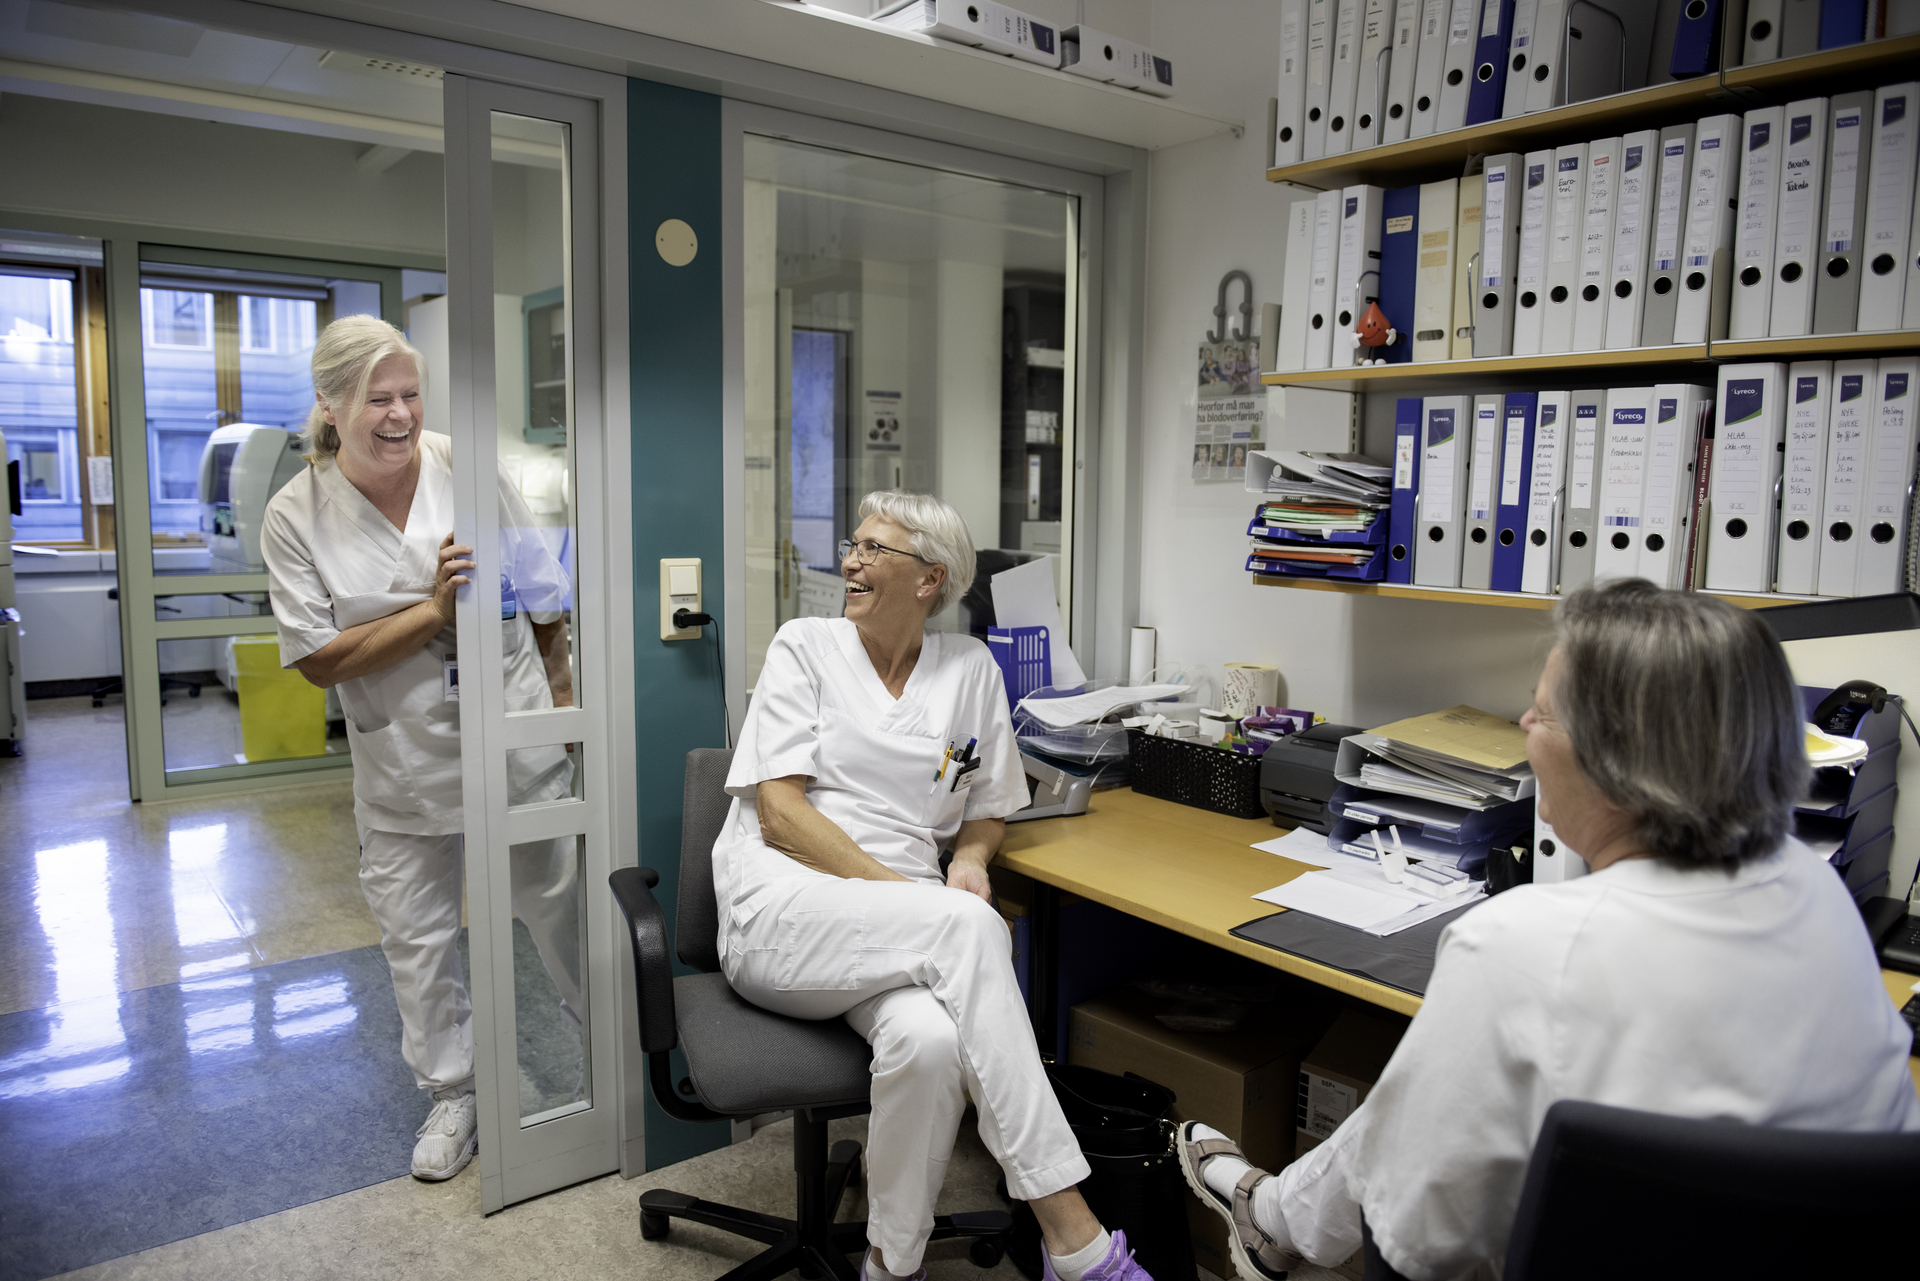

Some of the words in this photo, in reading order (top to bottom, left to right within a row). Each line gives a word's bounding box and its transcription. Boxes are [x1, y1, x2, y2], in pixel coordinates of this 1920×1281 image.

[1197, 401, 1224, 412] Hvorfor
[1226, 399, 1238, 411] må
[1239, 401, 1255, 410] man
[1196, 413, 1206, 423] ha
[1207, 410, 1264, 423] blodoverføring?
[1617, 411, 1643, 421] Lyreco
[1841, 408, 1855, 417] NYE
[1321, 1079, 1336, 1089] SSP+
